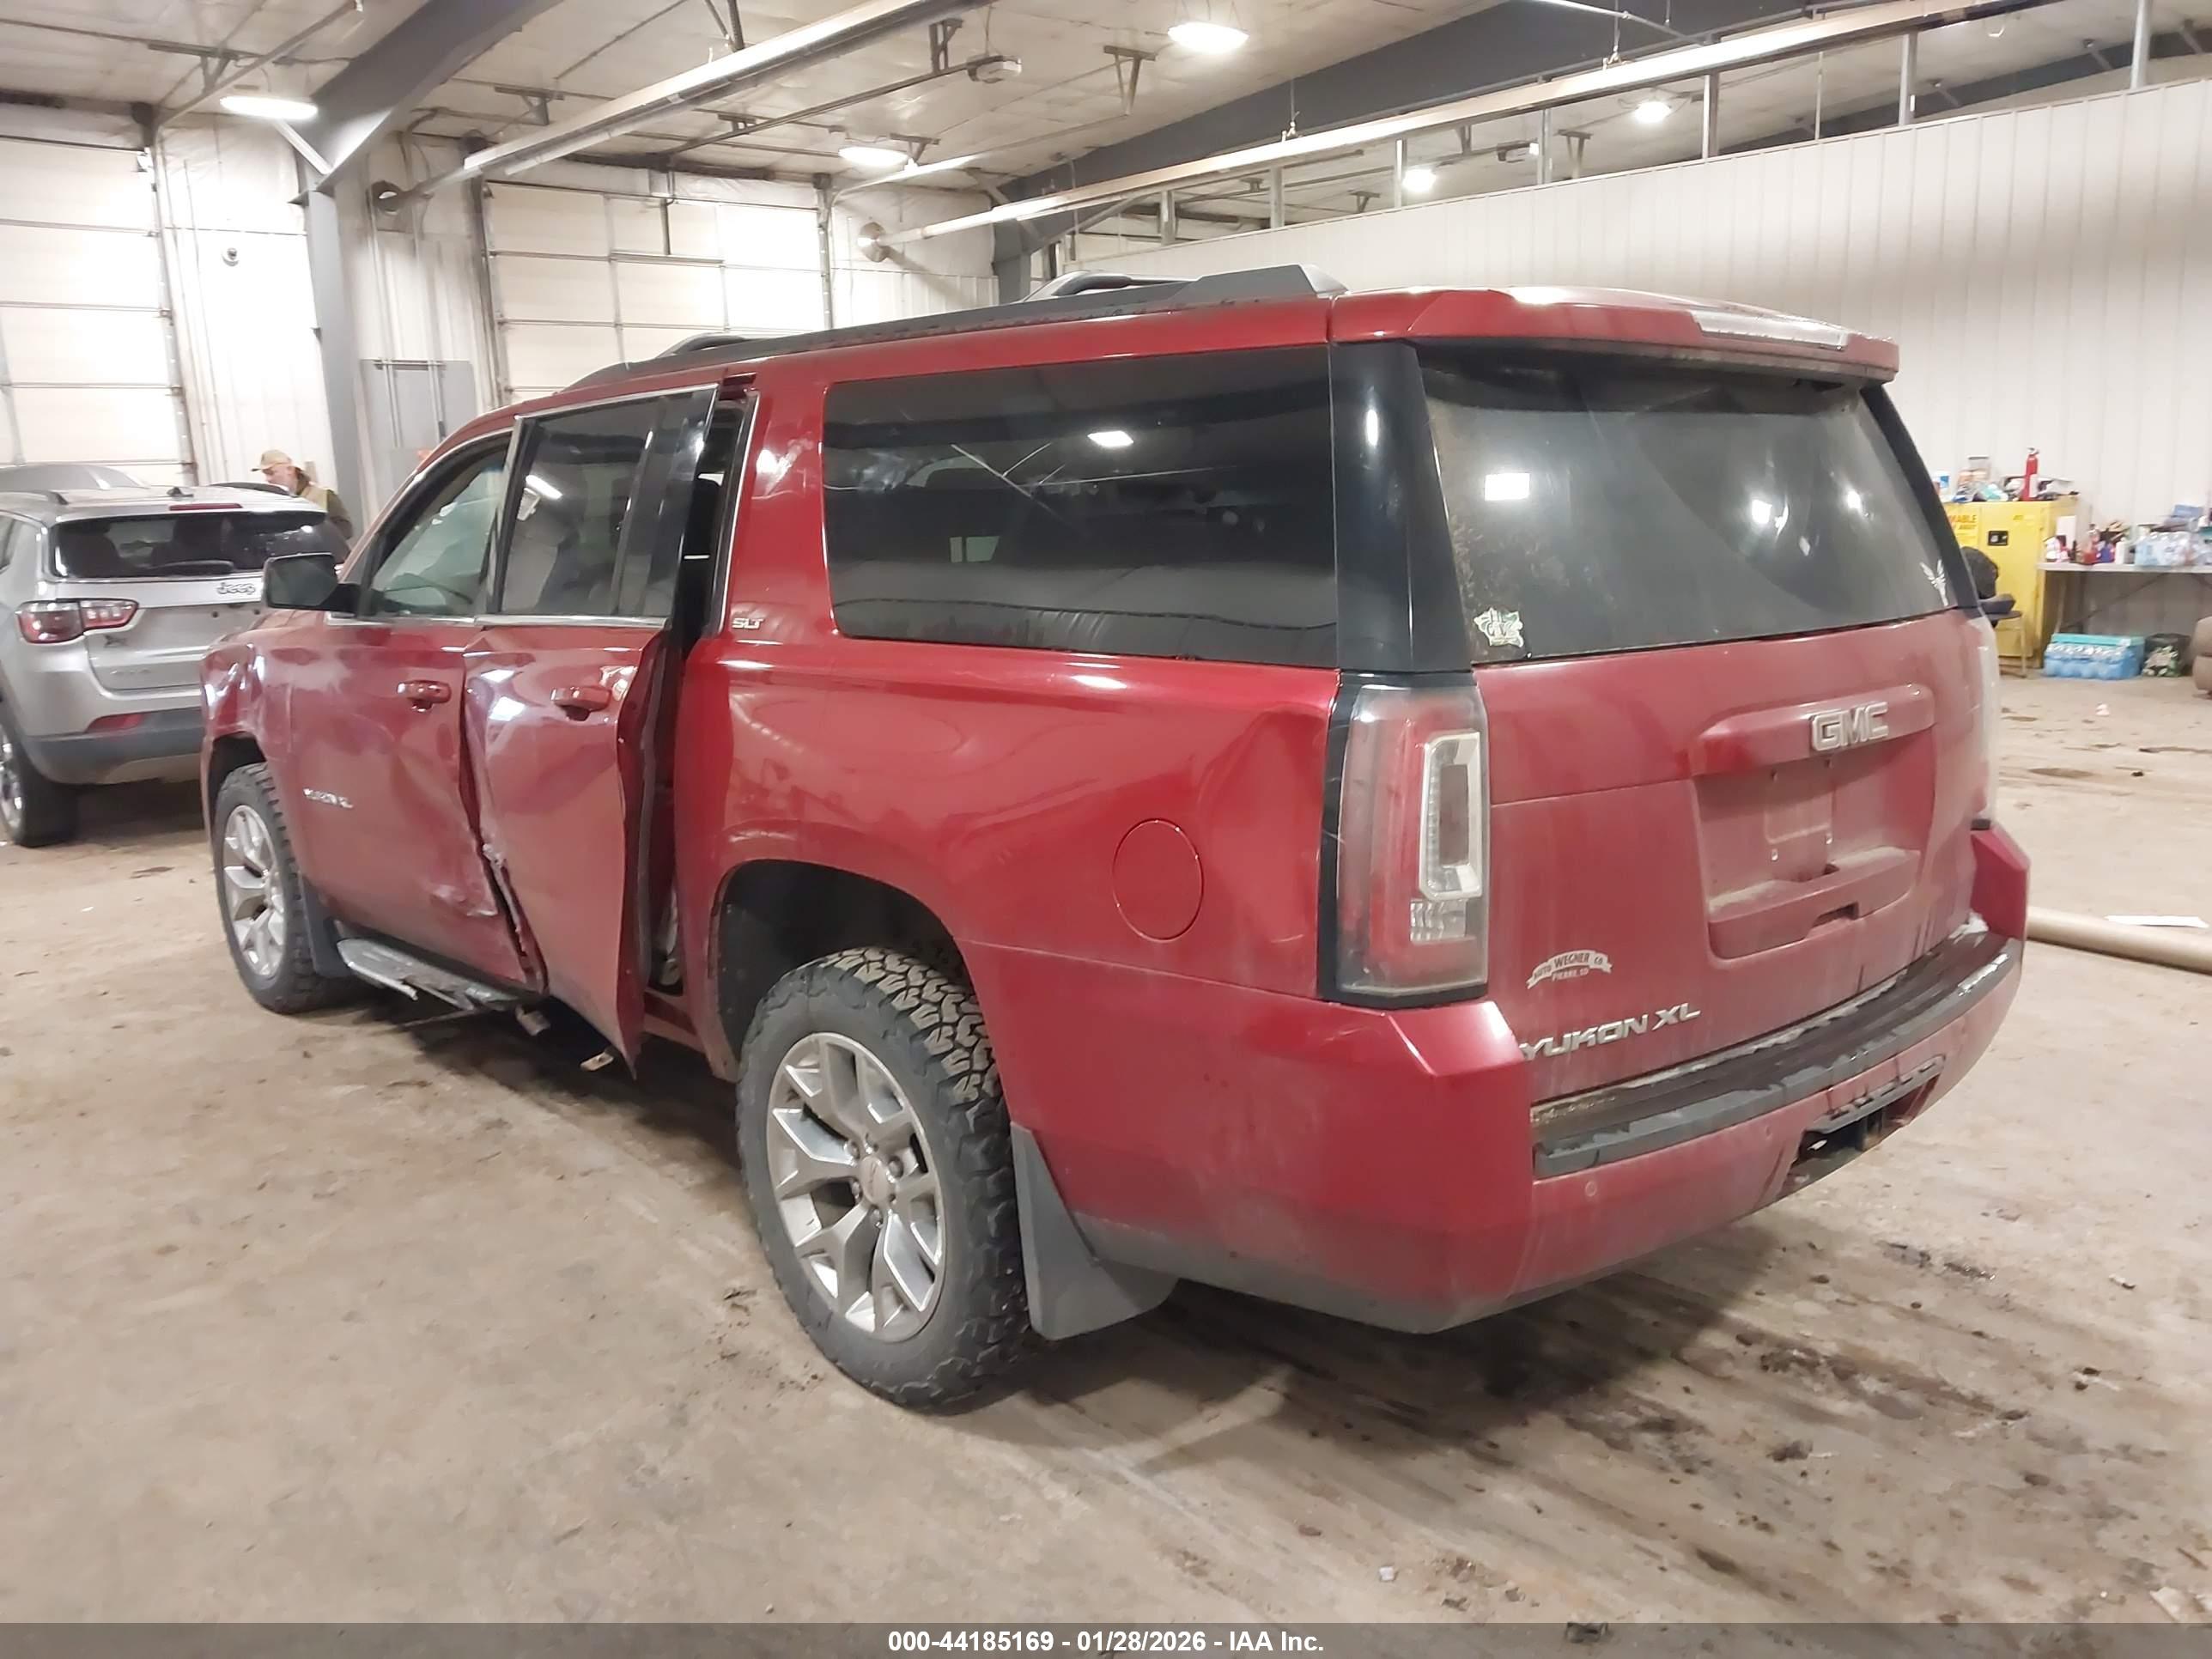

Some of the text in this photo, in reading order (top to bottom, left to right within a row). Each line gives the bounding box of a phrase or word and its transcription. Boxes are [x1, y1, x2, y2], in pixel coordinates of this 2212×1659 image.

[216, 582, 256, 595] Jeep
[732, 617, 765, 629] SLT
[1811, 702, 1889, 751] GMC
[1518, 1002, 1702, 1061] YUKON XL
